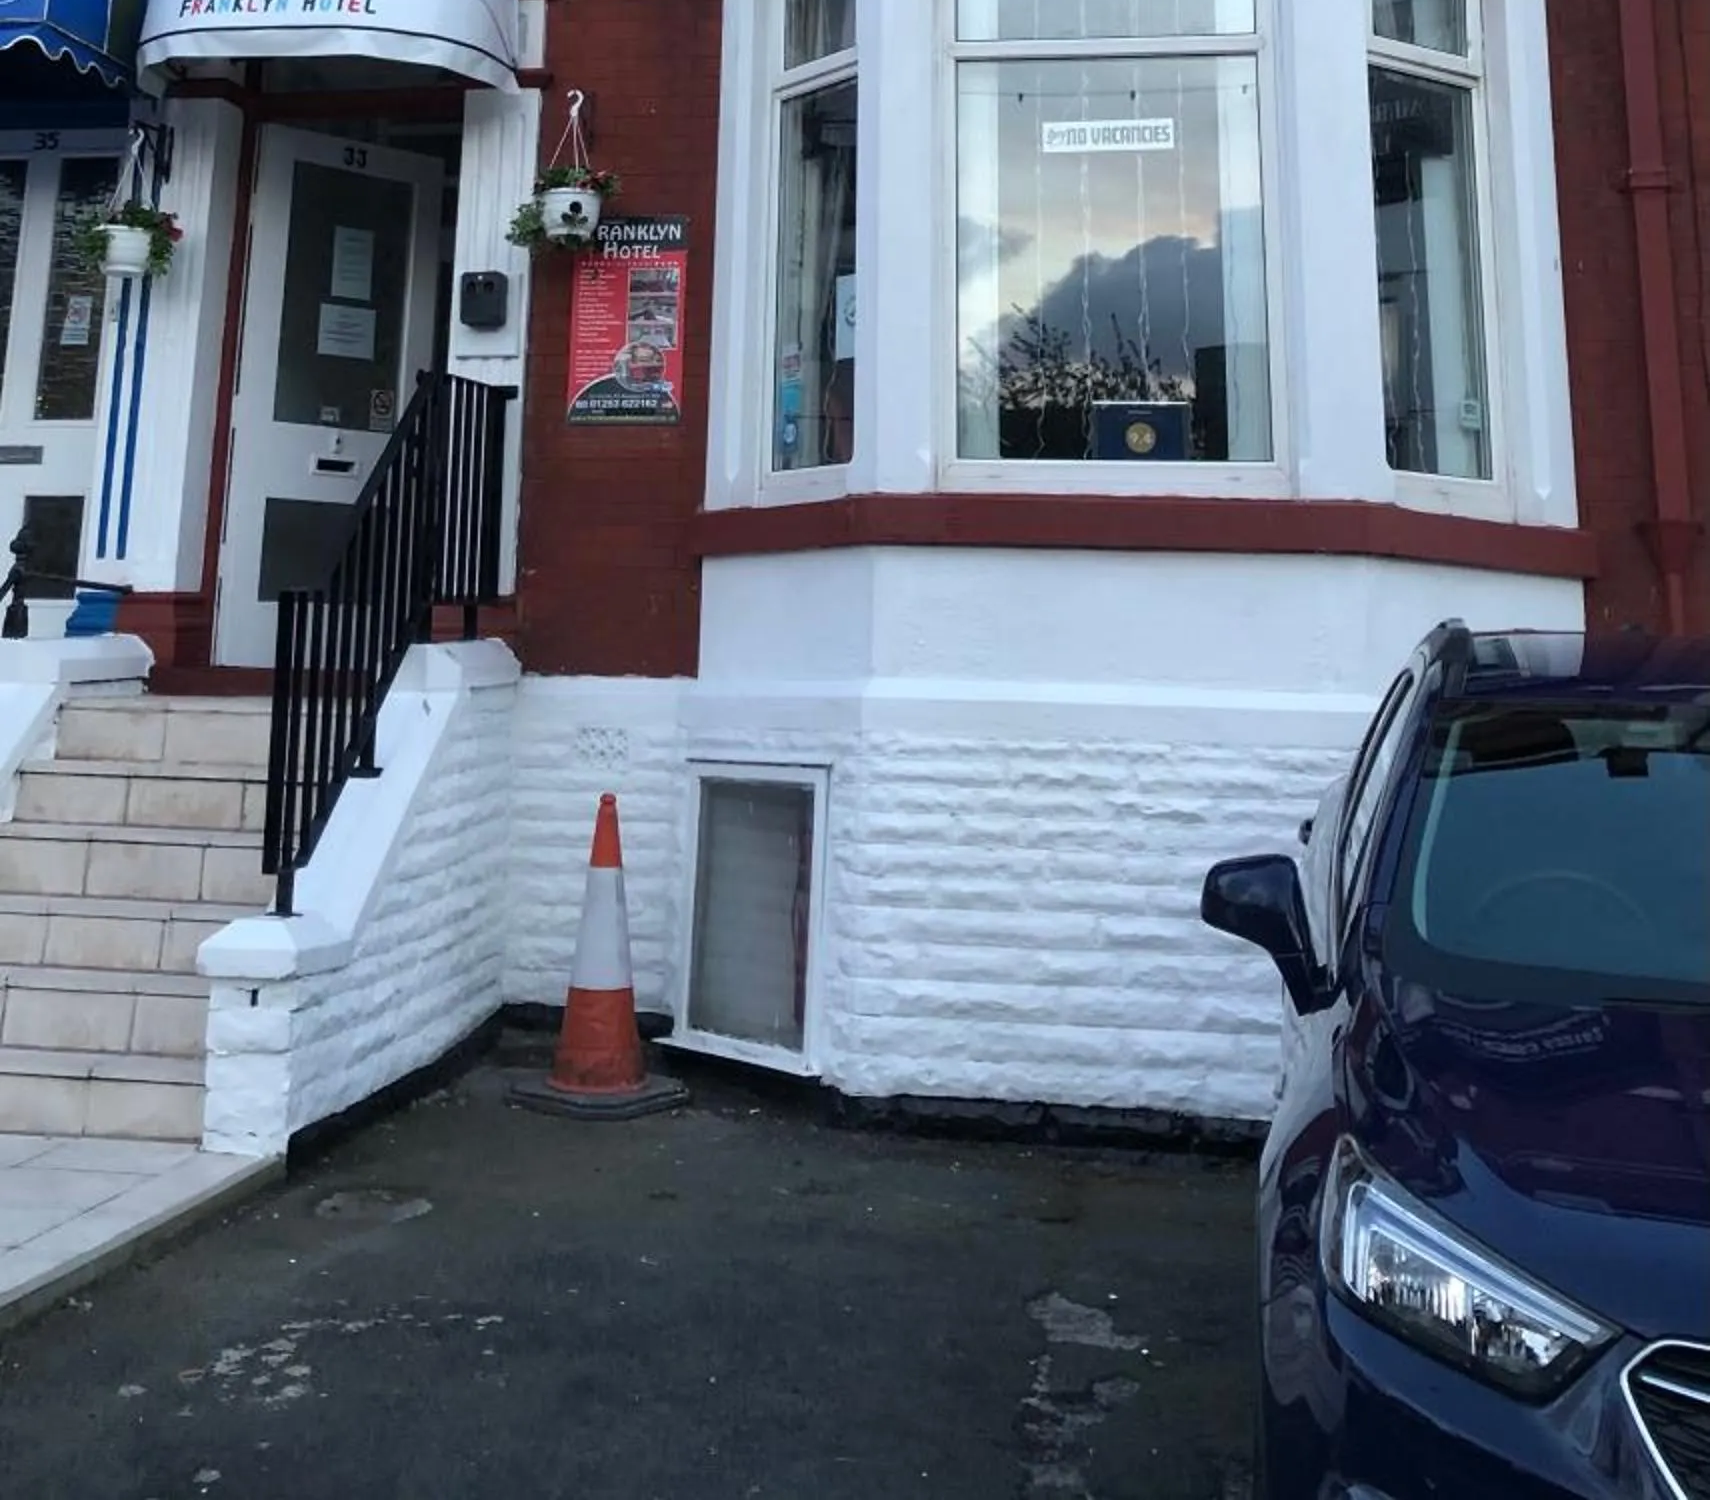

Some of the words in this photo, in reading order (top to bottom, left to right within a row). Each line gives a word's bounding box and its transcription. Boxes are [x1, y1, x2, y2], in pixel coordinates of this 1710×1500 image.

[33, 131, 61, 151] 35
[1066, 127, 1087, 146] NO
[1090, 125, 1172, 146] VACANCIES
[597, 223, 681, 241] RANKLYN
[603, 241, 661, 260] HOTEL
